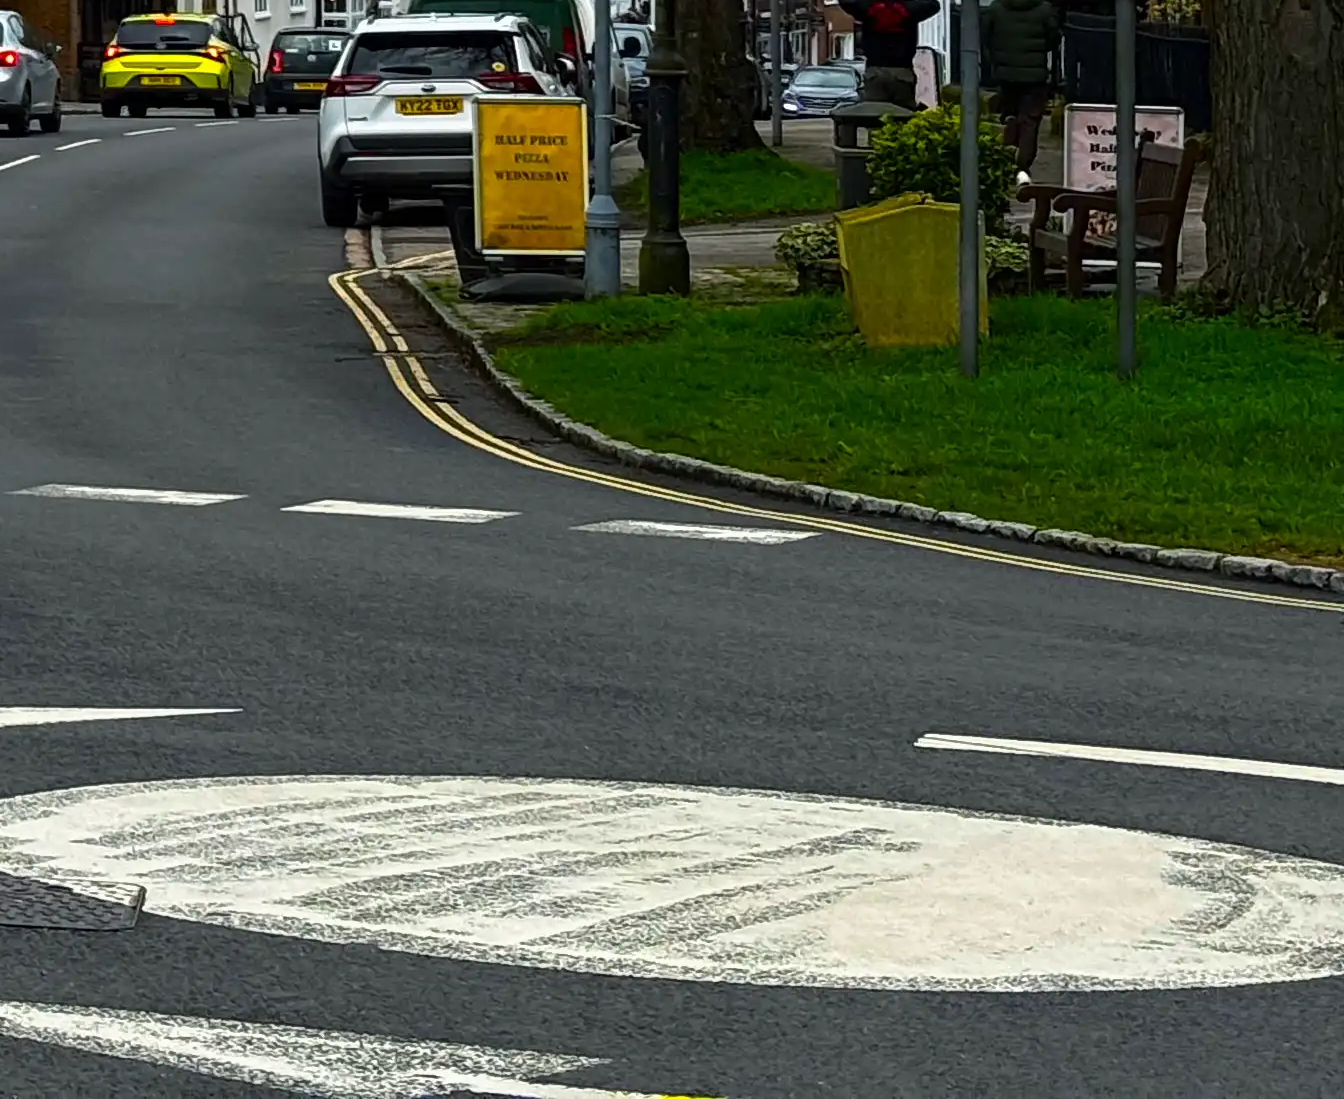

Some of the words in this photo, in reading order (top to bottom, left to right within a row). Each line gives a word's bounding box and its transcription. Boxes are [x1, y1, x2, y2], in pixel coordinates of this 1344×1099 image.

[495, 135, 526, 146] HALF
[530, 135, 568, 146] PRICE
[514, 153, 550, 164] PIZZA
[493, 170, 570, 182] WEDNESDAY
